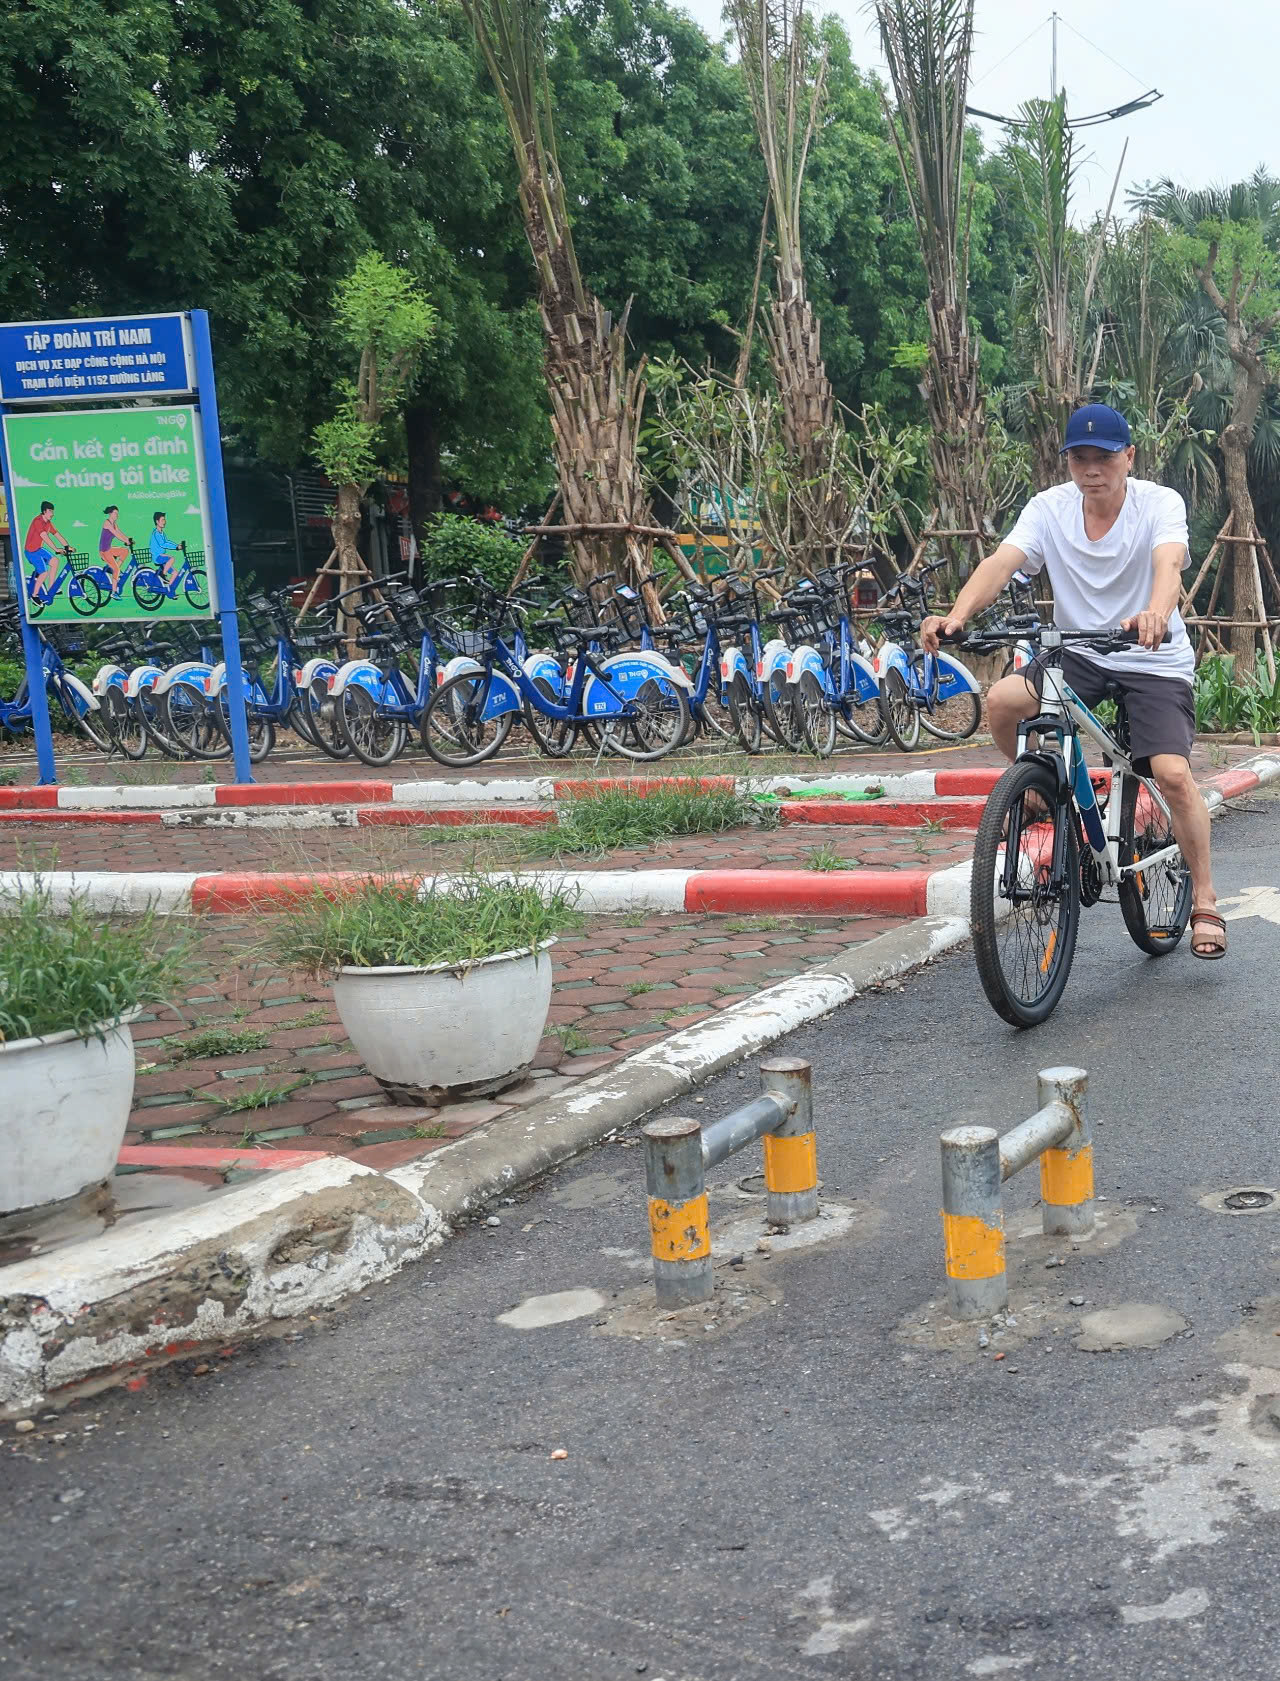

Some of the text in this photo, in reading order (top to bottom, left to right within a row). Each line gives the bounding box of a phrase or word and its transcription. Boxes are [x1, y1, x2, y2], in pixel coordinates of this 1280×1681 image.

[24, 327, 151, 354] TẬP ĐOÀN TRÍ NAM
[15, 351, 166, 373] DỊCH VỤ XE ĐẠP CÔNG CỘNG HÀ NỘI
[21, 378, 47, 391] TRẠM
[48, 373, 63, 388] ĐỐI
[86, 375, 108, 386] 1152
[109, 371, 139, 385] ĐƯỜNG
[141, 370, 165, 383] LÁNG
[29, 435, 188, 462] Gắn kết gia đình
[55, 464, 191, 491] chúng tôi bike
[492, 692, 506, 704] TN
